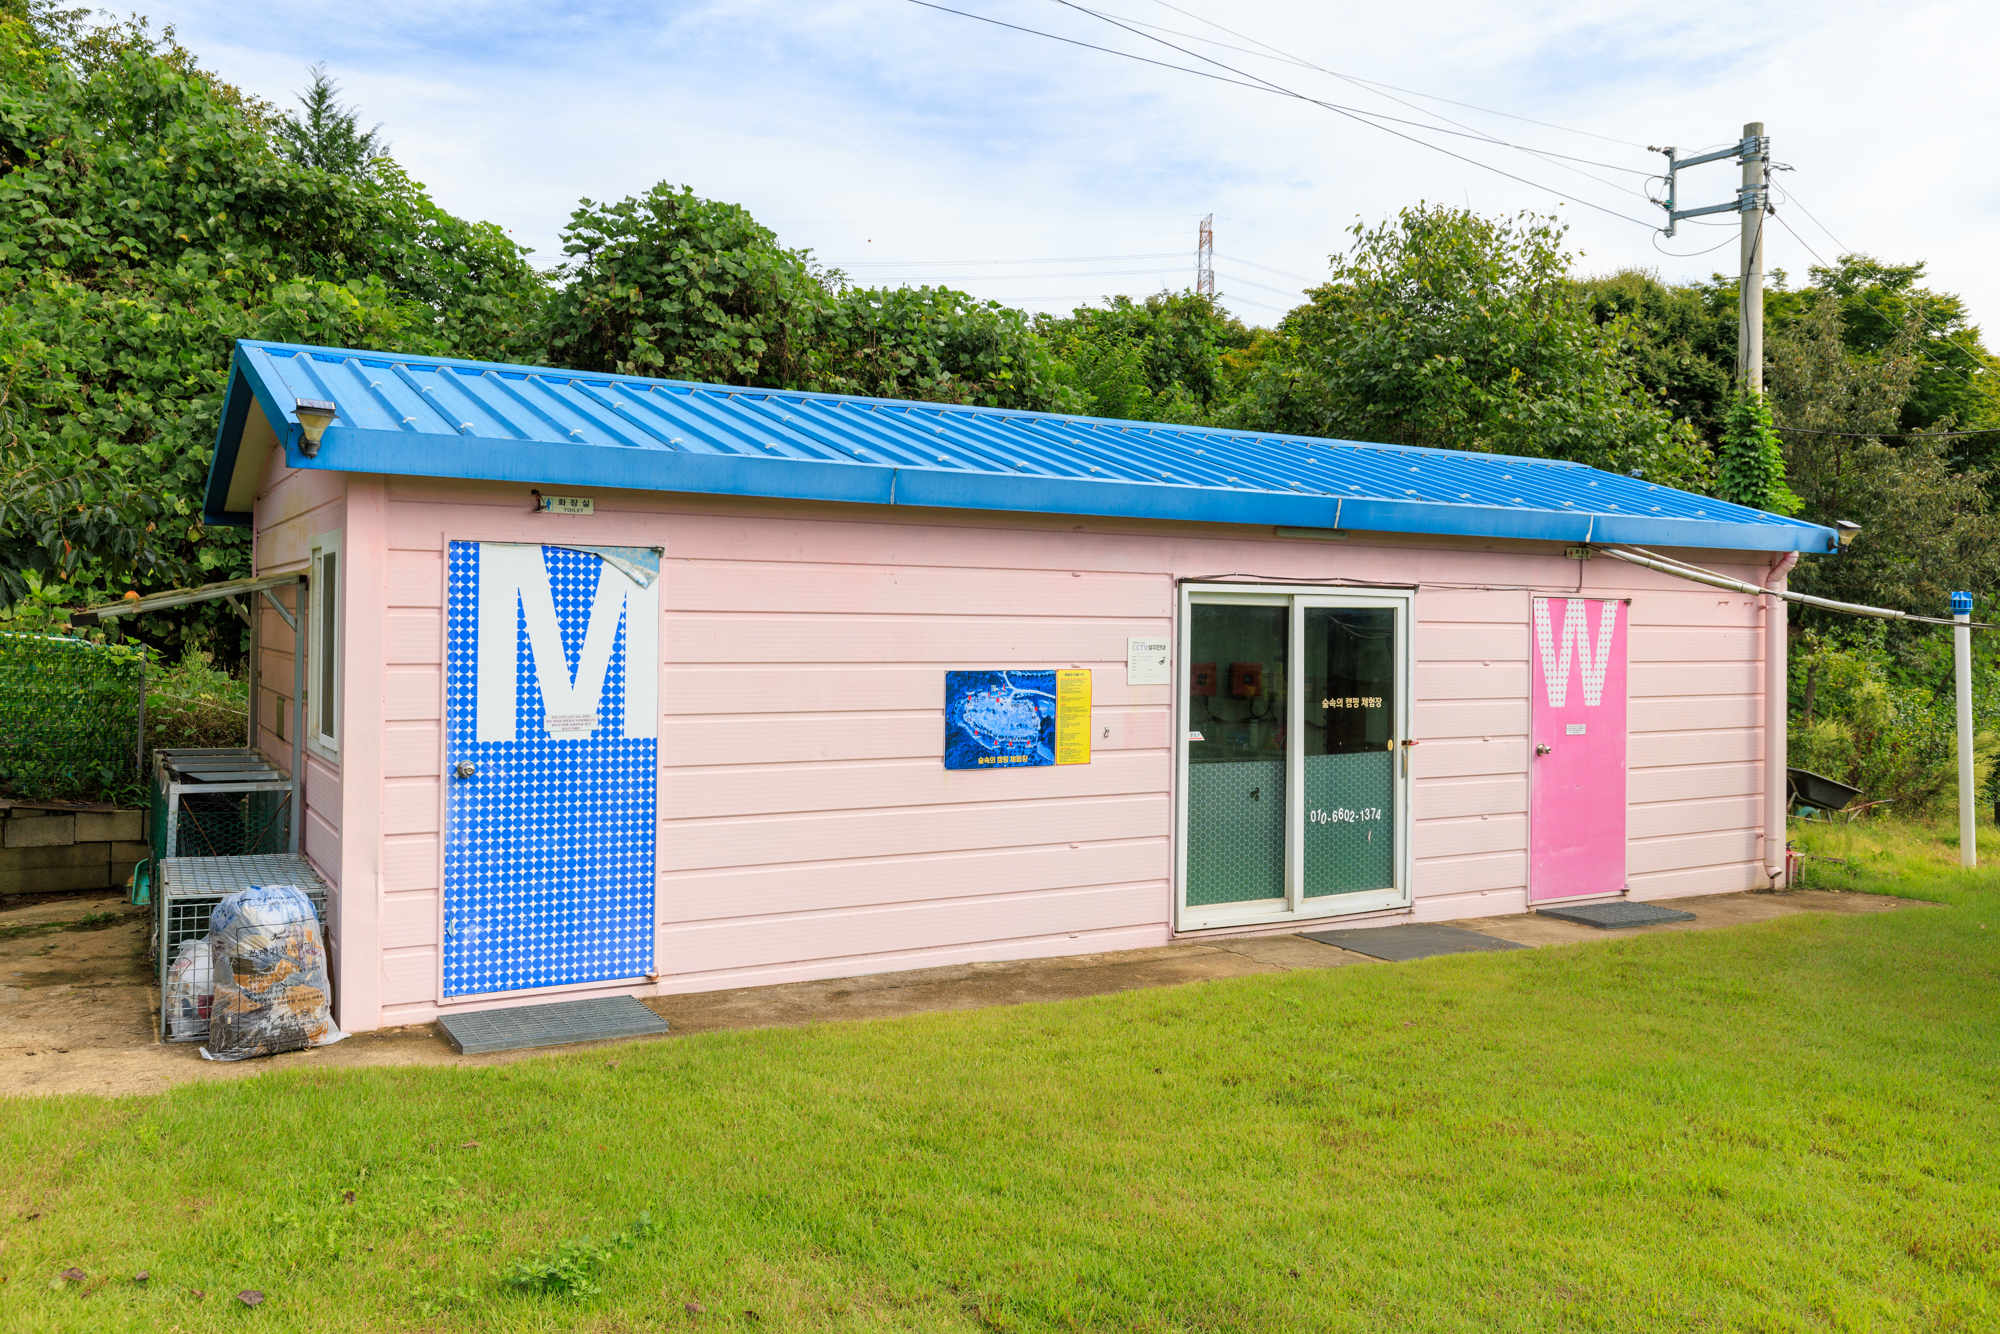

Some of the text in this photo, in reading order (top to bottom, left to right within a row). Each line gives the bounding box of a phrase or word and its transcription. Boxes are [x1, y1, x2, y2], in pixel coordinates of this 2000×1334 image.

[558, 498, 590, 507] 화장실
[476, 543, 658, 742] M
[1533, 598, 1619, 708] W
[1322, 696, 1382, 709] 숲속의 캠핑 체험장
[978, 756, 996, 765] 숲속의
[1010, 755, 1028, 763] 체험장
[1310, 807, 1382, 825] 010-6602-1374
